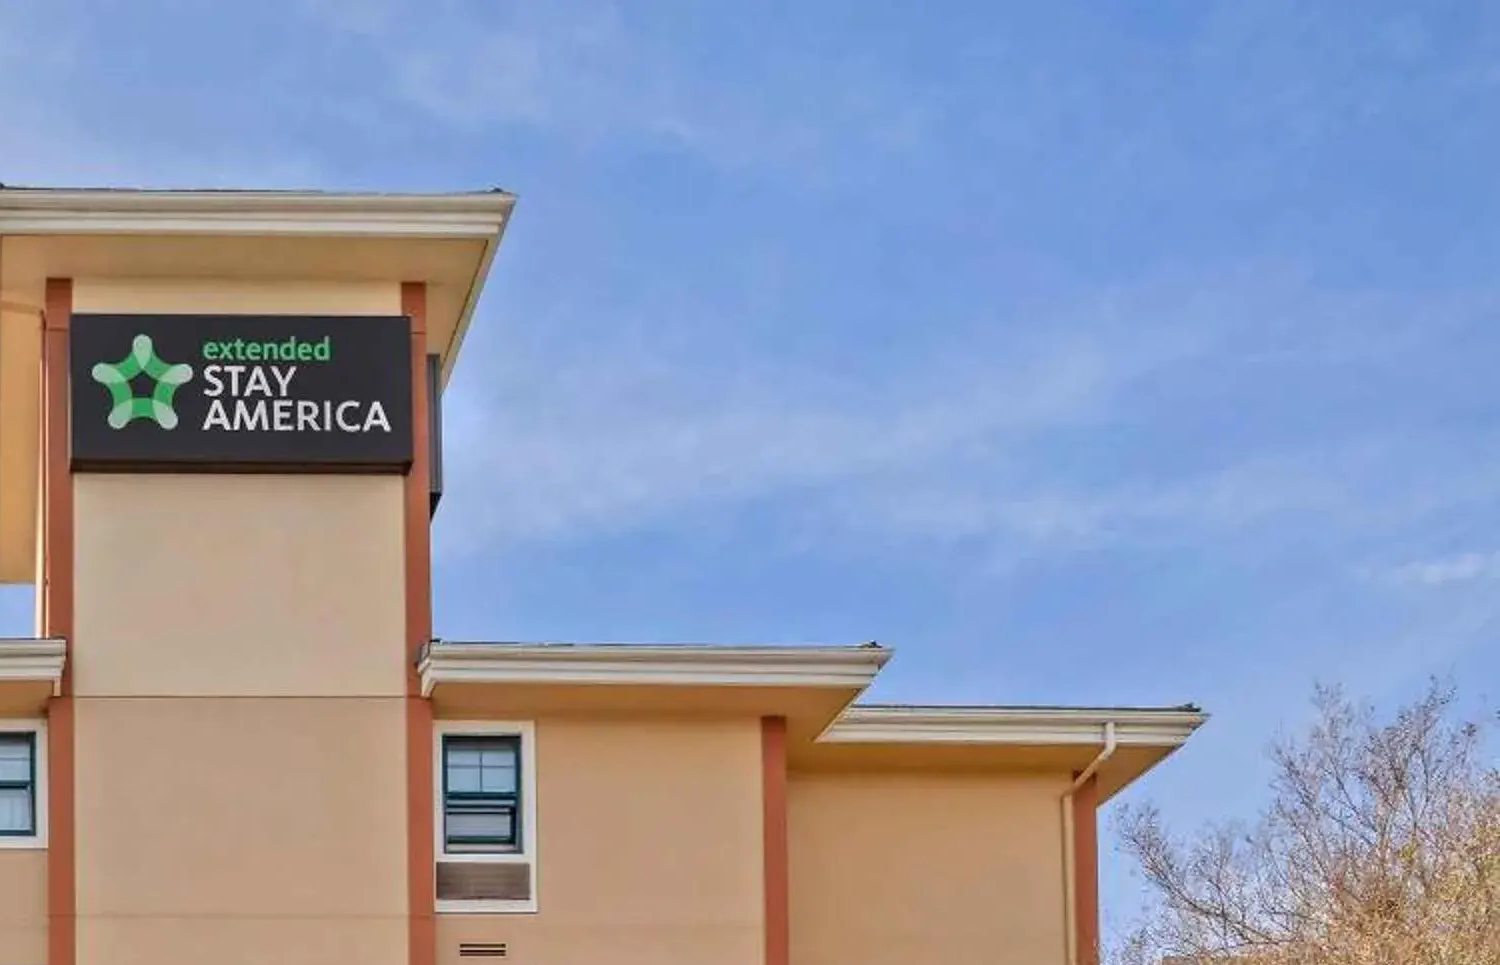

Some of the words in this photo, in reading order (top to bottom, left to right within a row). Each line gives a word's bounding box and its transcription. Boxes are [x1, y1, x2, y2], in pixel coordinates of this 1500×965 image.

[202, 336, 330, 361] extended
[203, 365, 297, 397] STAY
[202, 400, 392, 432] AMERICA
